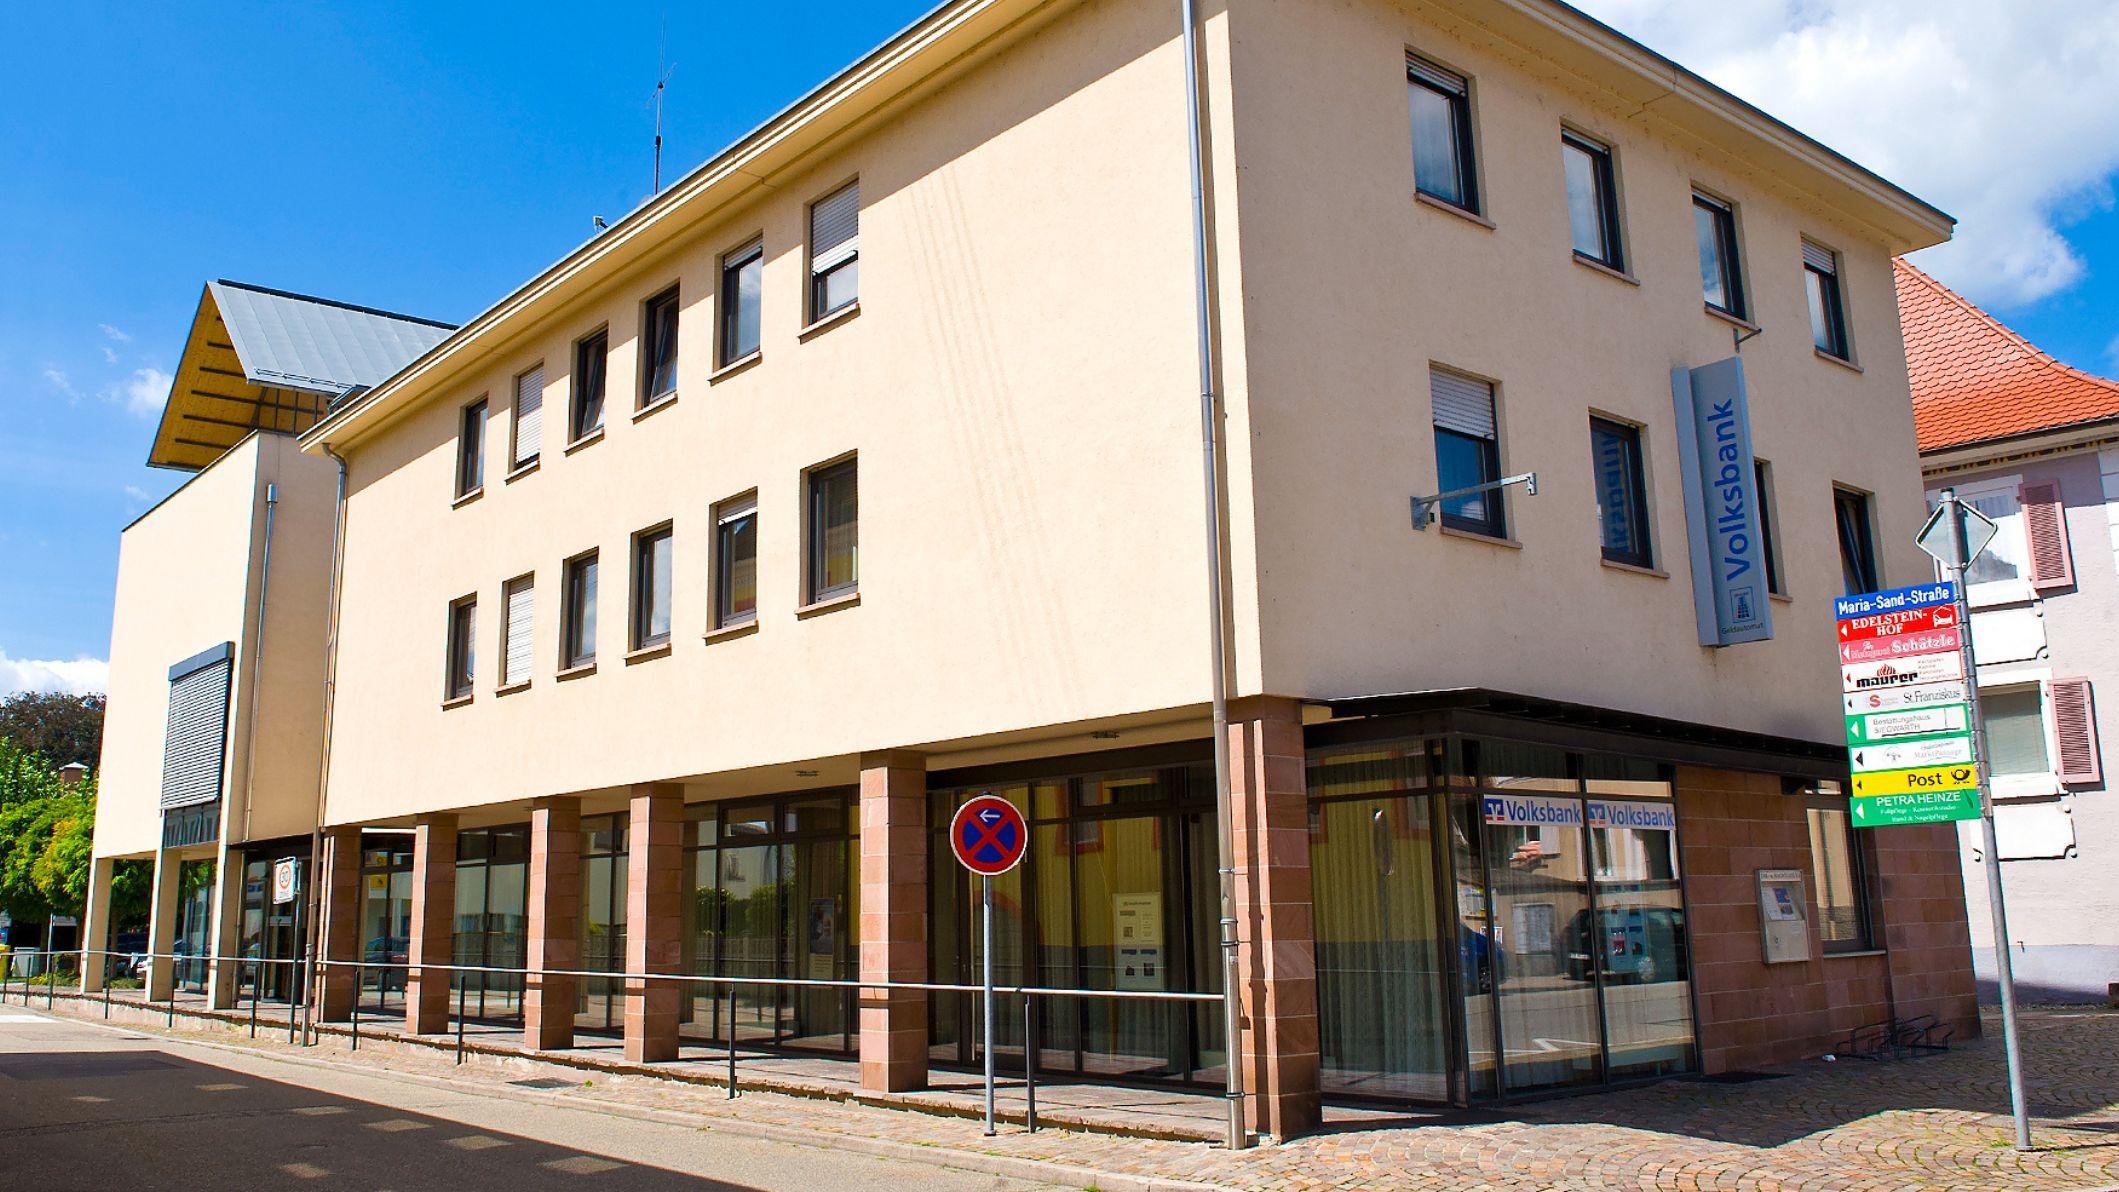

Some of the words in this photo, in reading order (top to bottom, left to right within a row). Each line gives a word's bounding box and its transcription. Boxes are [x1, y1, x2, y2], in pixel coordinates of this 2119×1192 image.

[1707, 398, 1750, 581] Volksbank
[1838, 586, 1950, 615] Maria-Sand-Straße
[1852, 610, 1928, 630] EDELSTEIN-
[1877, 623, 1903, 636] HOF
[1891, 634, 1955, 653] Schätzle
[1856, 672, 1918, 688] maurer
[1908, 773, 1943, 787] Post
[1876, 795, 1915, 807] PETRA
[1917, 791, 1961, 804] HEINZE
[1507, 799, 1581, 823] Volksbank
[1606, 804, 1675, 827] Volksbank
